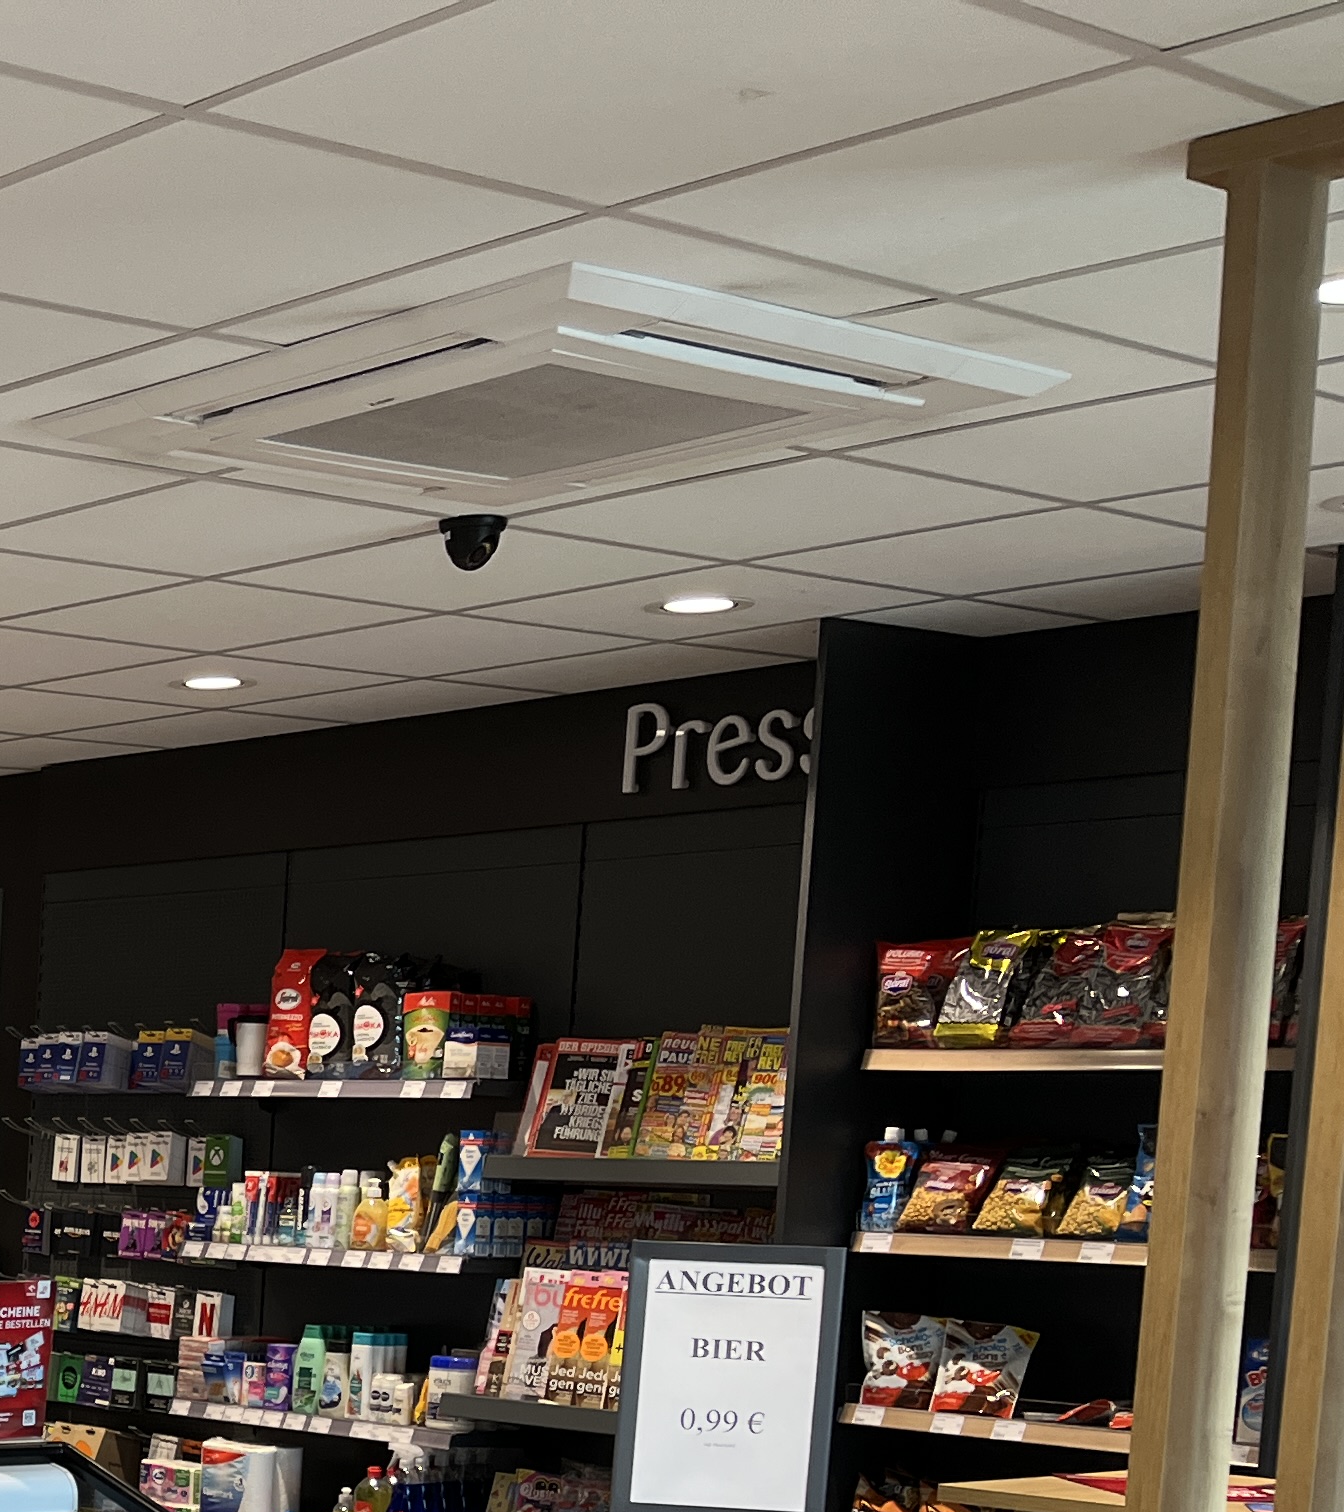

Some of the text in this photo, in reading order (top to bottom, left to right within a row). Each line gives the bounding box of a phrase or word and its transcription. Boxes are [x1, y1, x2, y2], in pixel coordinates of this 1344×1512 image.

[582, 1043, 620, 1054] SPIEGE
[565, 1079, 612, 1092] TÄGLICHE
[578, 1093, 598, 1105] ZIEL
[561, 1104, 605, 1116] HYBRIDE
[655, 1270, 813, 1298] ANGEBOT
[4, 1318, 51, 1330] BESTELLEN
[691, 1337, 766, 1362] BIER
[680, 1407, 766, 1434] 0,99 €
